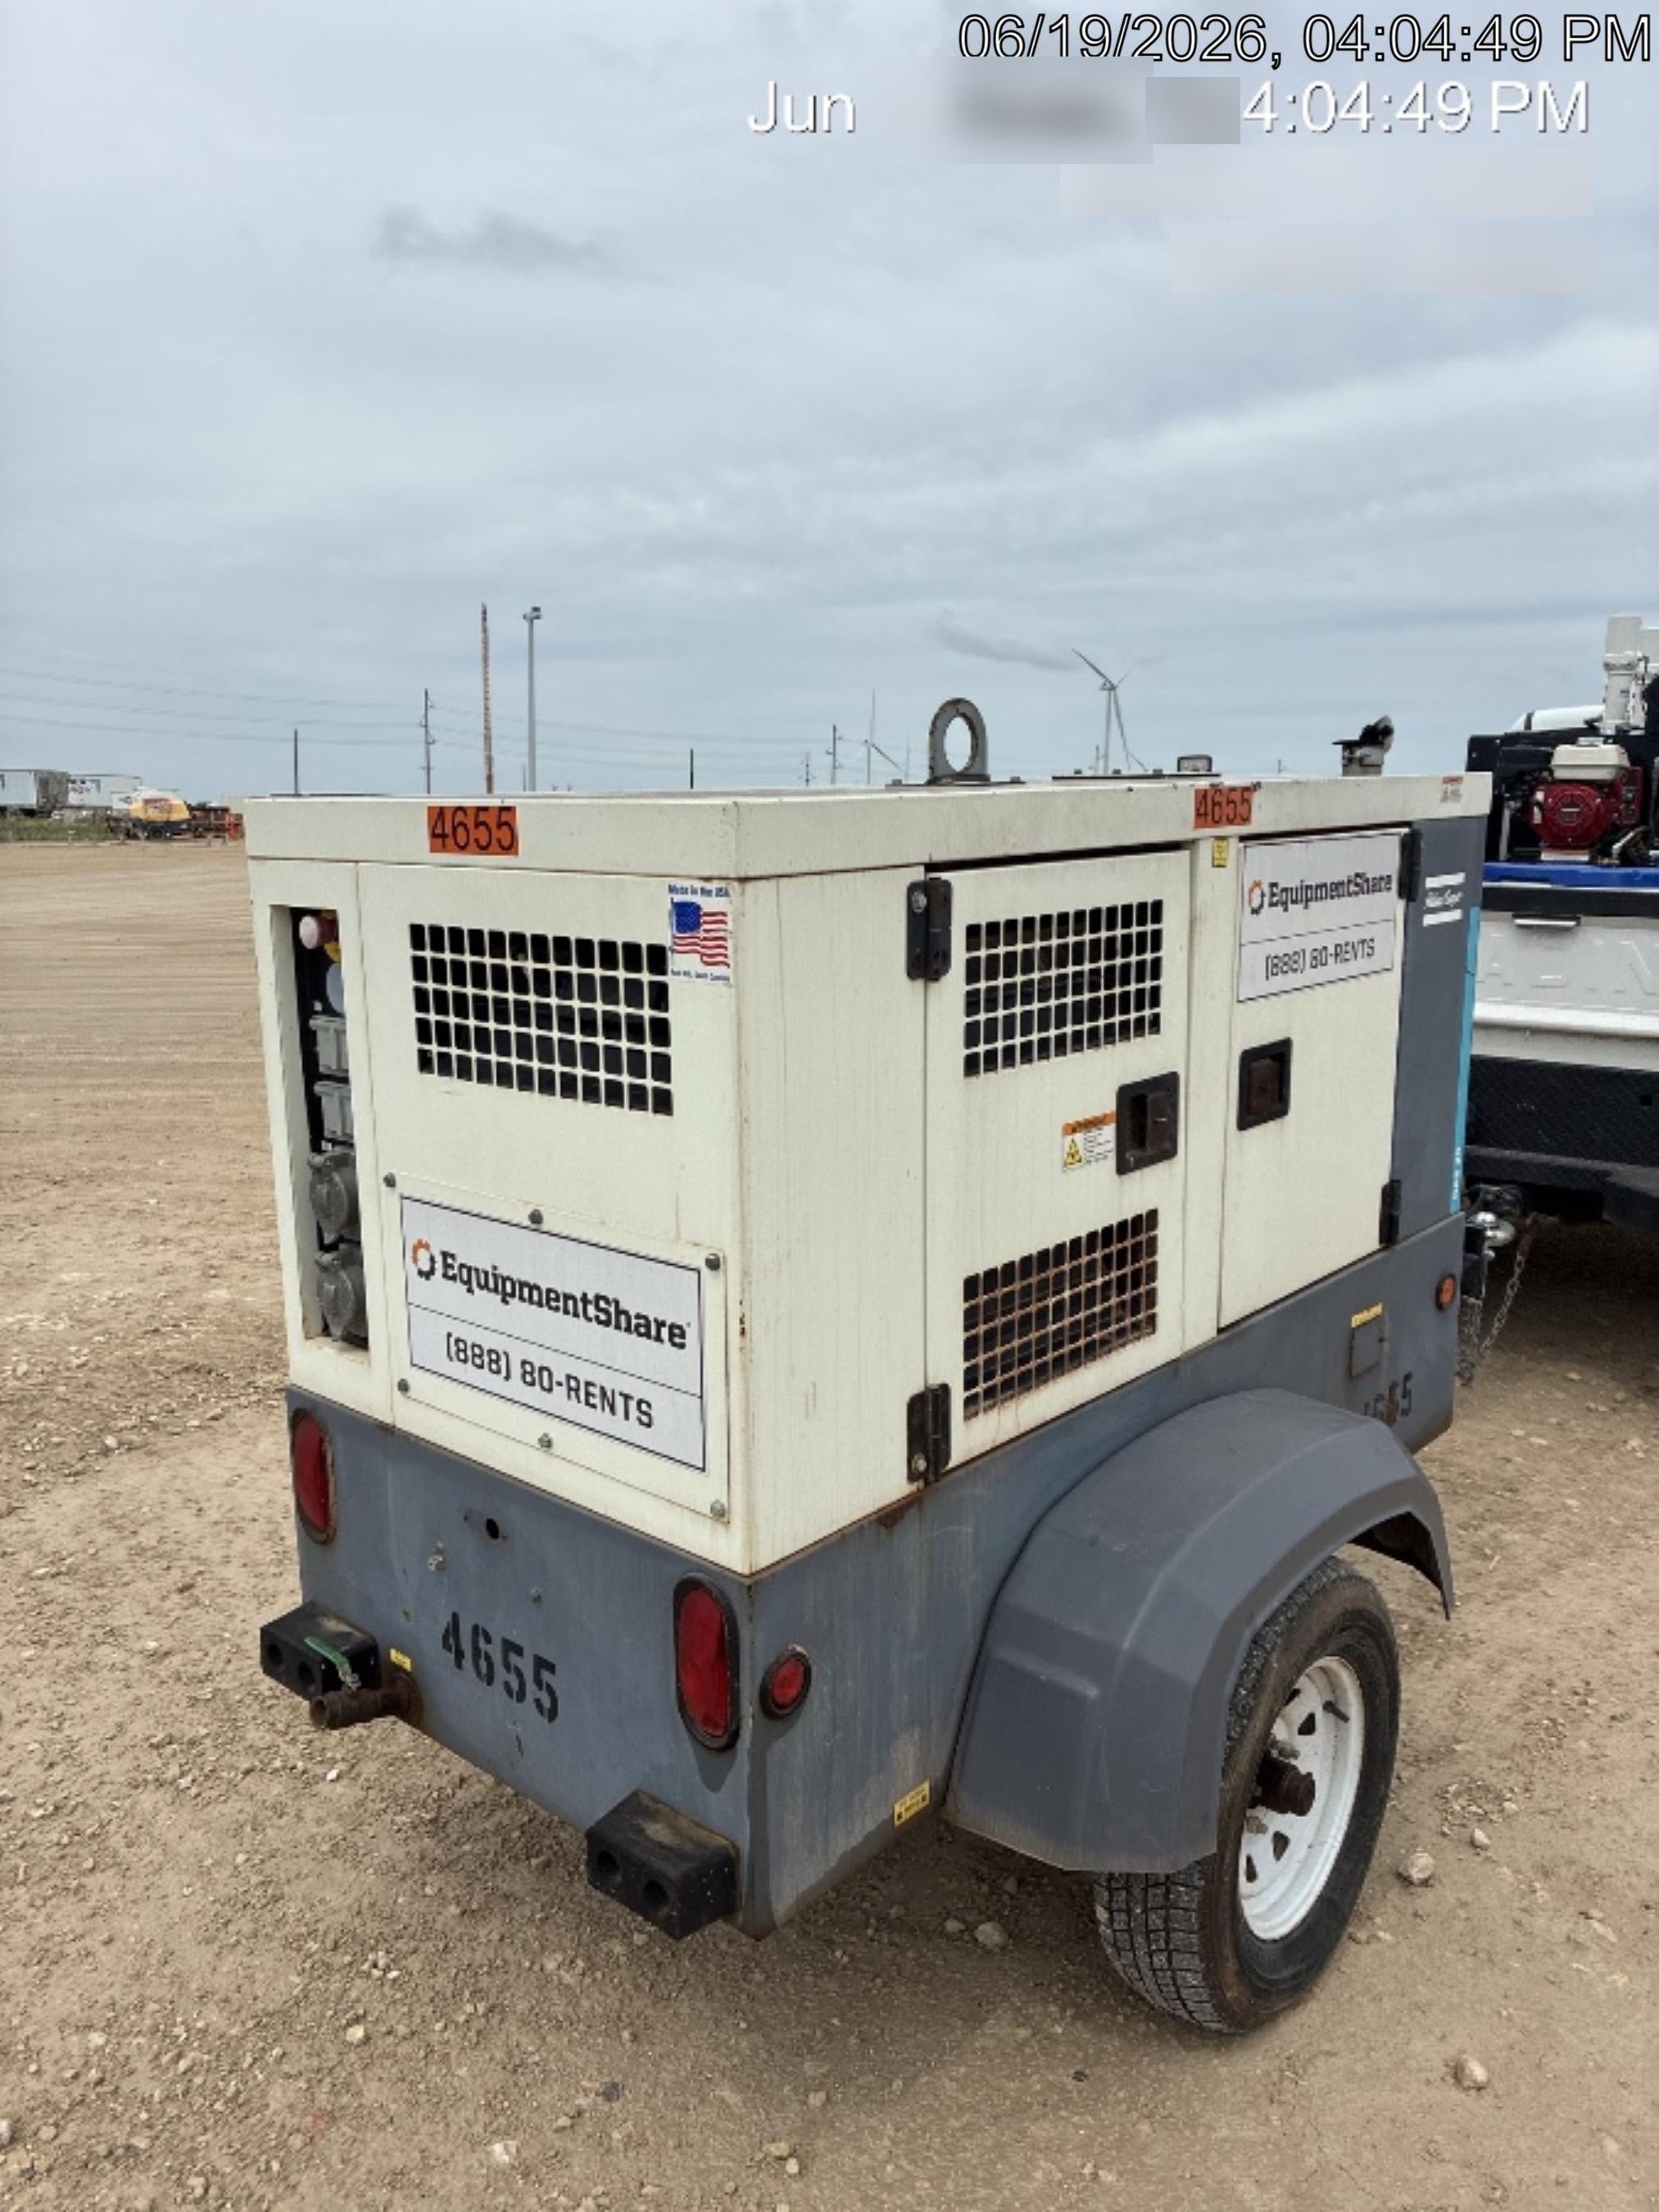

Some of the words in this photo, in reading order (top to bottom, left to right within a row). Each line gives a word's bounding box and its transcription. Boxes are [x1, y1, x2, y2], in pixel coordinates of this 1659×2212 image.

[429, 806, 516, 851] 4655
[1194, 787, 1253, 825] 4655
[1267, 872, 1393, 912] EquipmentShare
[1265, 948, 1307, 981] (888)
[1310, 937, 1376, 970] 80-RENTS
[440, 1250, 687, 1350] EquipmentShare
[446, 1331, 512, 1382] (888)
[520, 1358, 654, 1430] 80-RENTS
[441, 1611, 560, 1725] 4655
